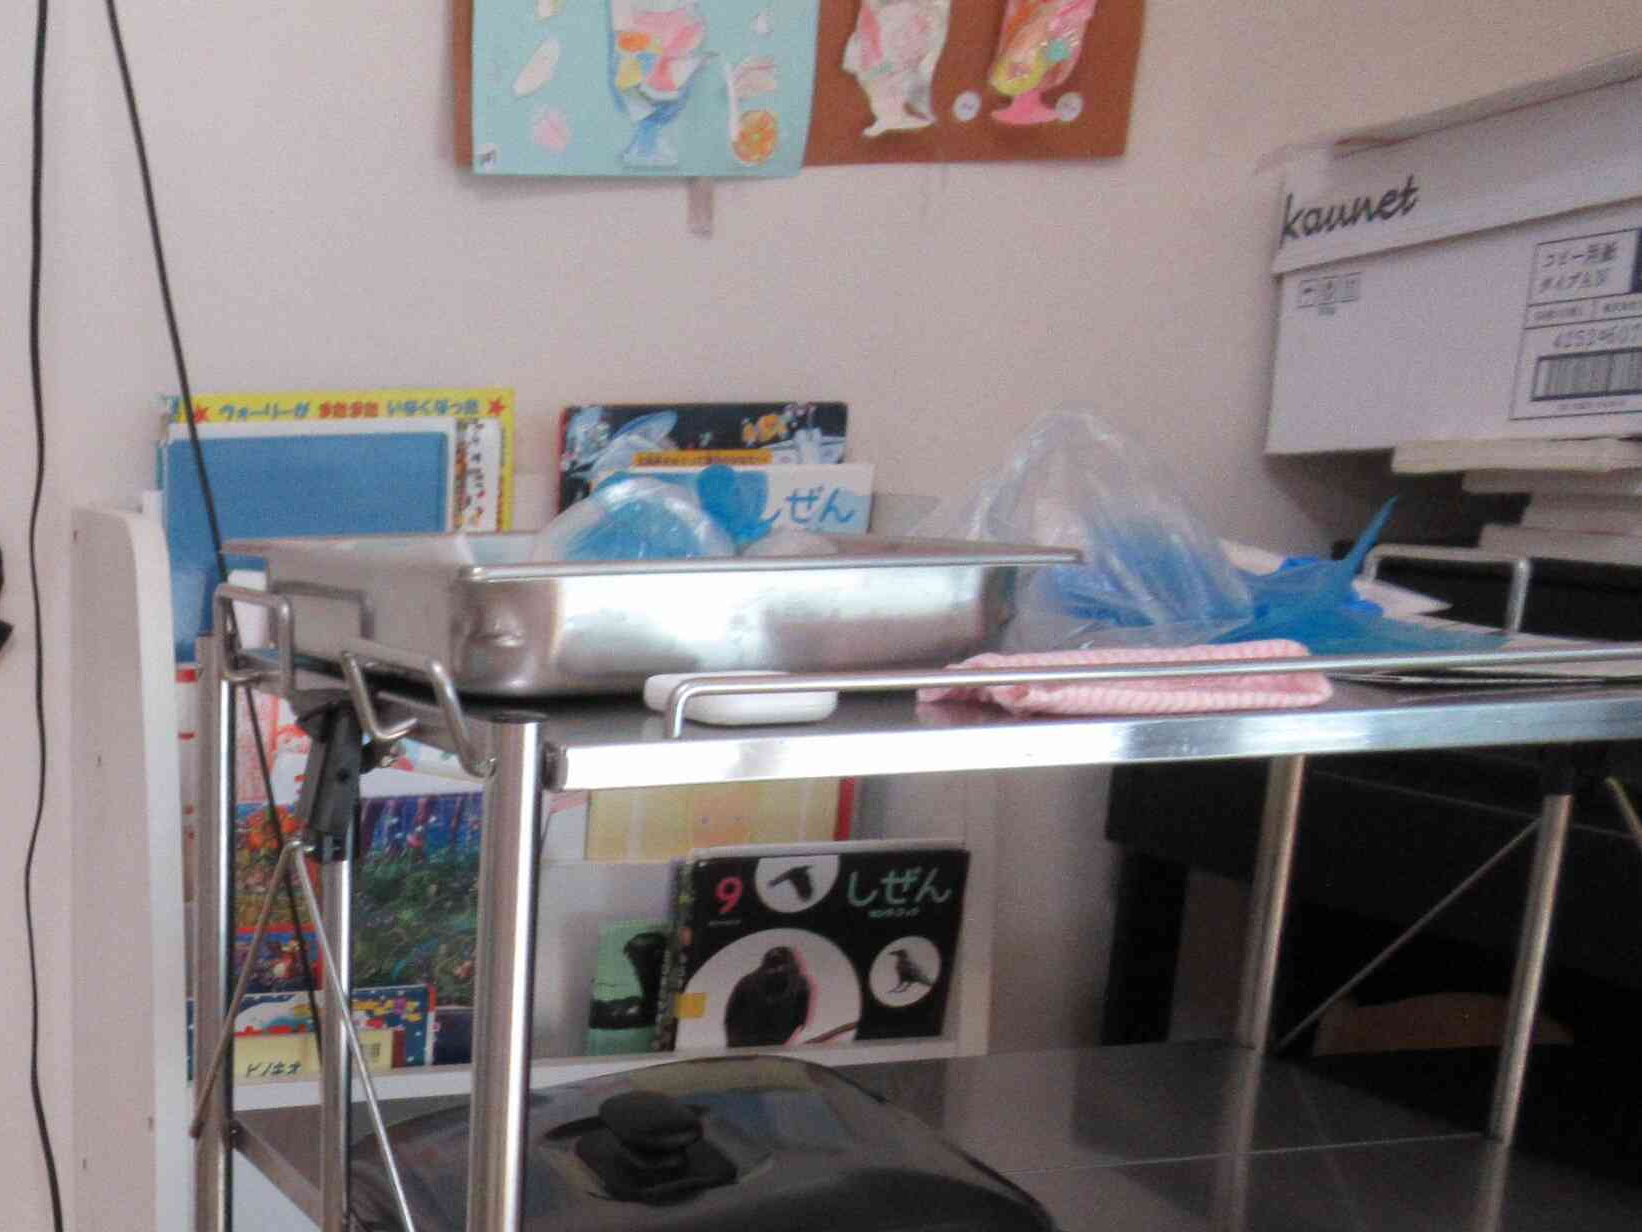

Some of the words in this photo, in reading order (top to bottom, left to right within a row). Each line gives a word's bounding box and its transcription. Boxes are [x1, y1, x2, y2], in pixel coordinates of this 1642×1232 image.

[1280, 174, 1420, 248] kaunet
[715, 876, 743, 914] 9
[847, 866, 951, 907] しぜん
